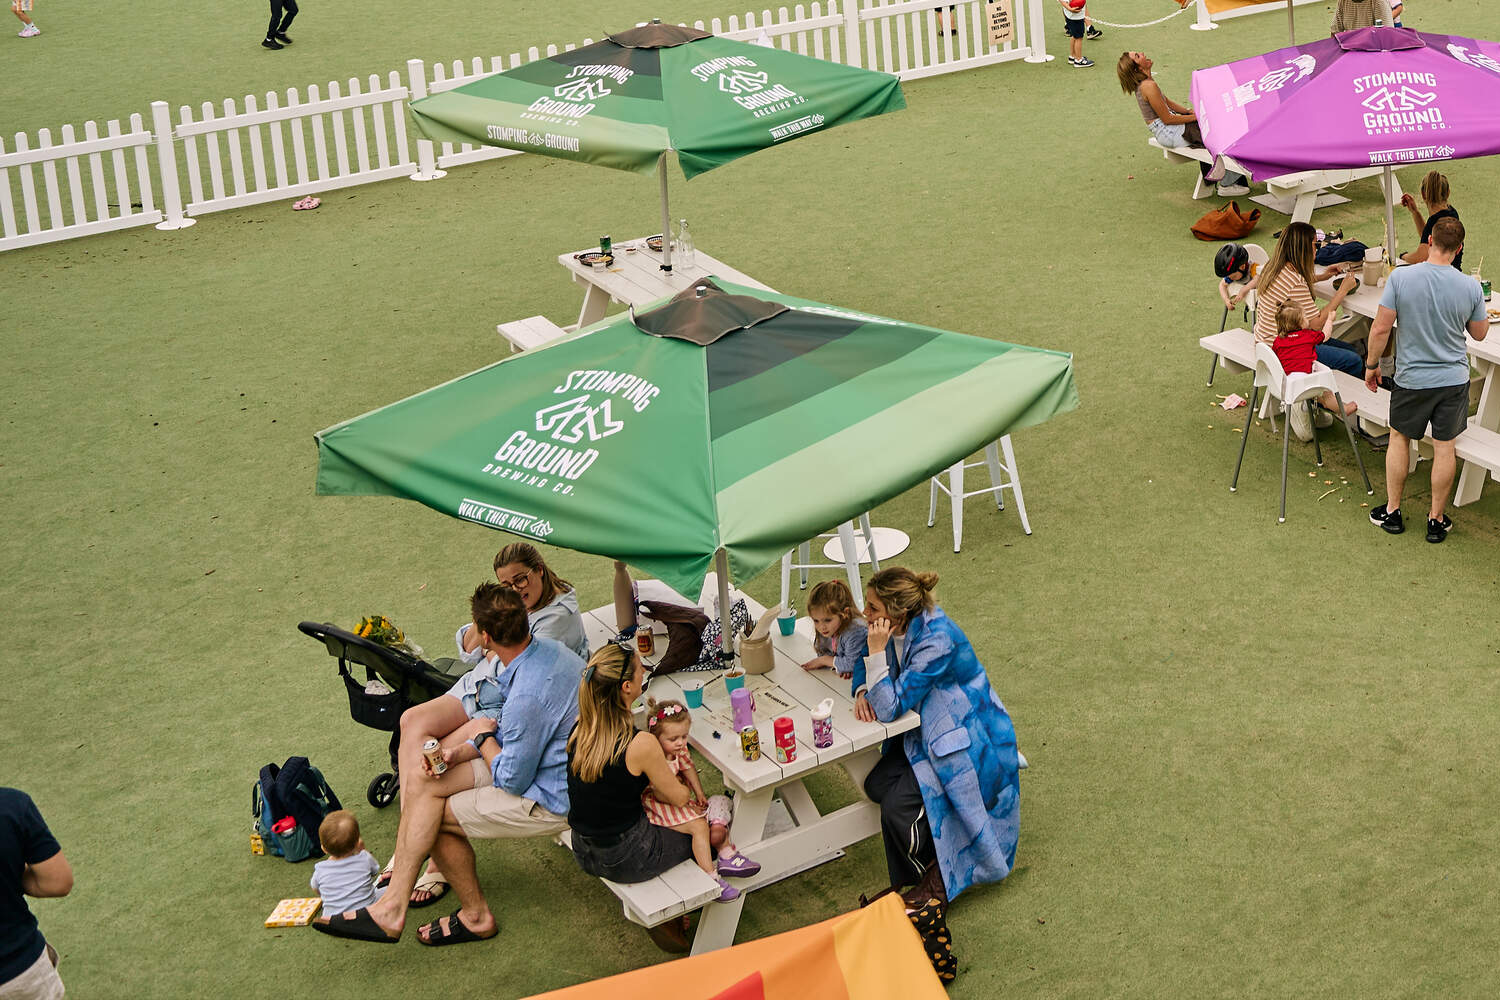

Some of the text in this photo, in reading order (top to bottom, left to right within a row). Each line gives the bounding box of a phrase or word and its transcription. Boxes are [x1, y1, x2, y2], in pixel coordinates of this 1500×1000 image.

[992, 11, 1007, 19] ALCOHOL
[565, 64, 635, 85] STOMPING
[691, 56, 757, 82] STOMPING
[1353, 72, 1437, 93] STOMPING
[528, 96, 596, 118] GROUND
[732, 84, 797, 110] GROUND
[753, 100, 791, 118] BREWING
[1363, 107, 1442, 128] GROUND
[487, 125, 580, 152] STOMPING GROUND
[1367, 124, 1423, 135] BREWING
[1369, 148, 1434, 163] WALK THIS WAY
[553, 370, 660, 413] STOMPING
[494, 430, 600, 480] GROUND
[481, 463, 575, 496] BREWING CO.
[458, 502, 532, 532] WALK THIS WAY
